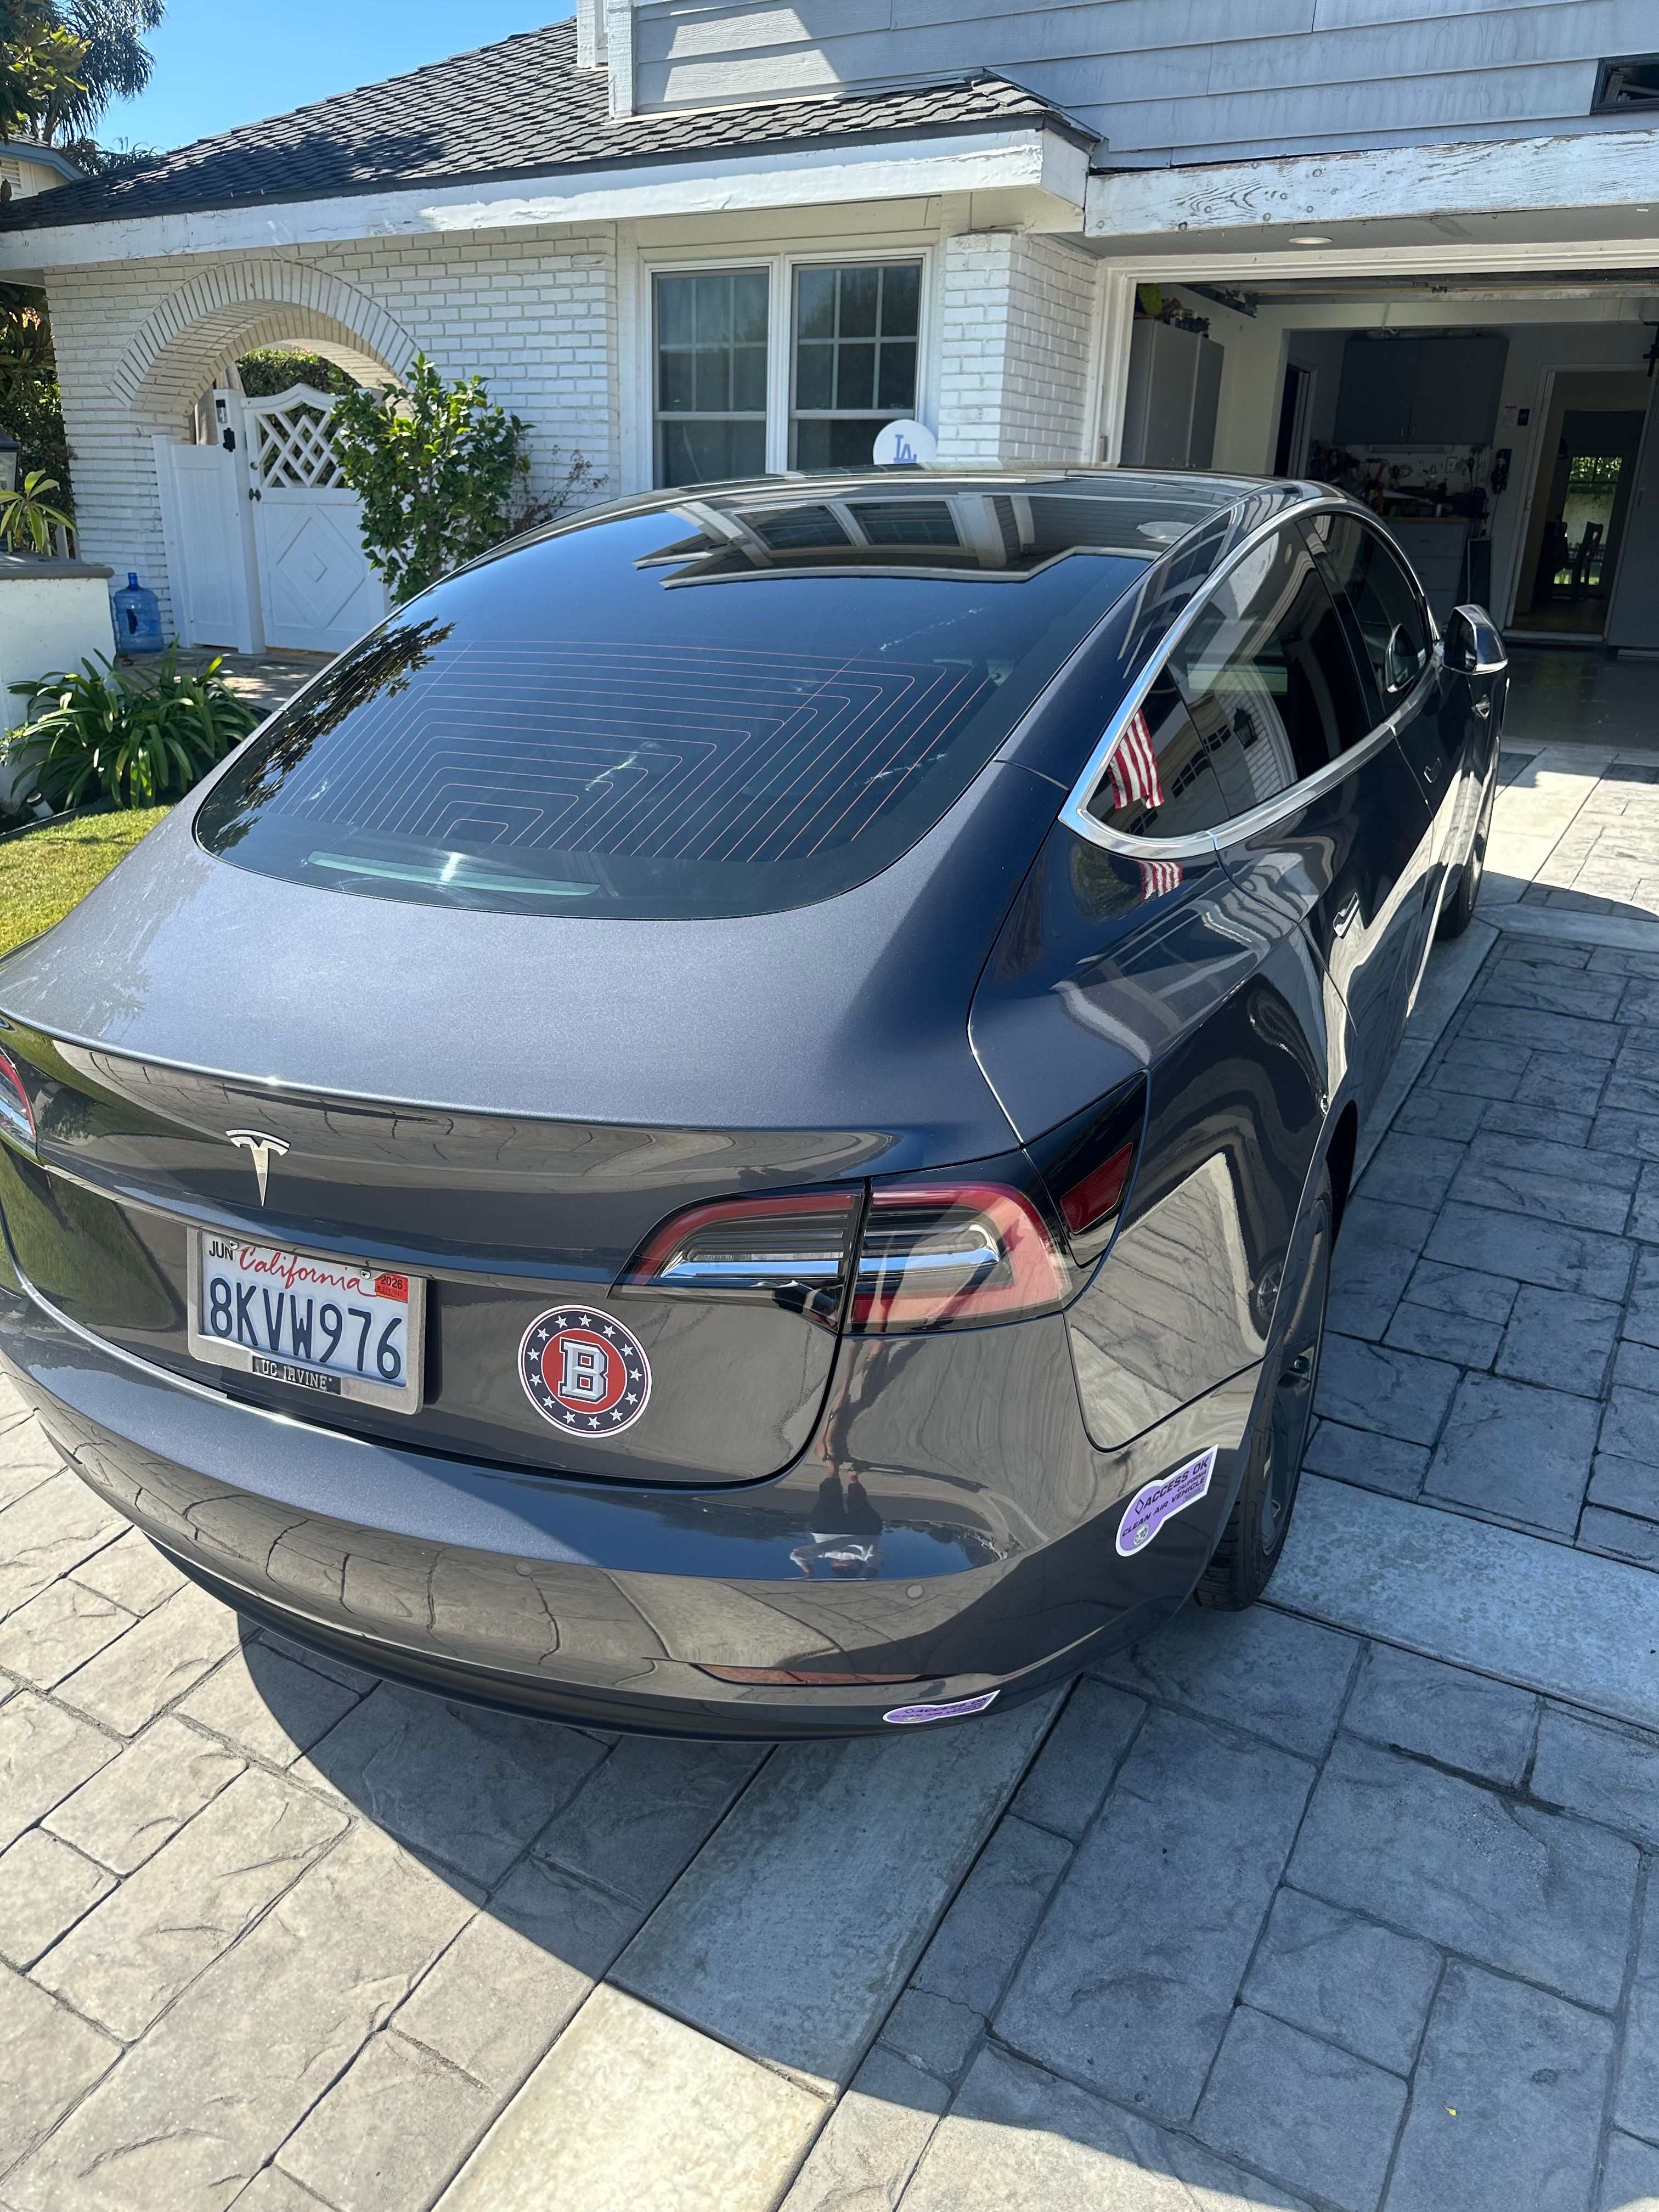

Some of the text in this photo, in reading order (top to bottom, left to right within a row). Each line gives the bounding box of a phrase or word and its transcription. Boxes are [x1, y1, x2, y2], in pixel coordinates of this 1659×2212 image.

[209, 1240, 233, 1261] JUN
[240, 1246, 377, 1297] California
[380, 1276, 403, 1290] 2026
[210, 1277, 402, 1379] 8KVW976
[261, 1359, 278, 1376] UC
[558, 1336, 609, 1404] B
[1122, 1512, 1152, 1537] CLEAN
[1153, 1500, 1169, 1515] AIR
[1171, 1476, 1206, 1503] VEHICLE
[1143, 1470, 1189, 1510] ACCESS
[1192, 1457, 1209, 1475] OK
